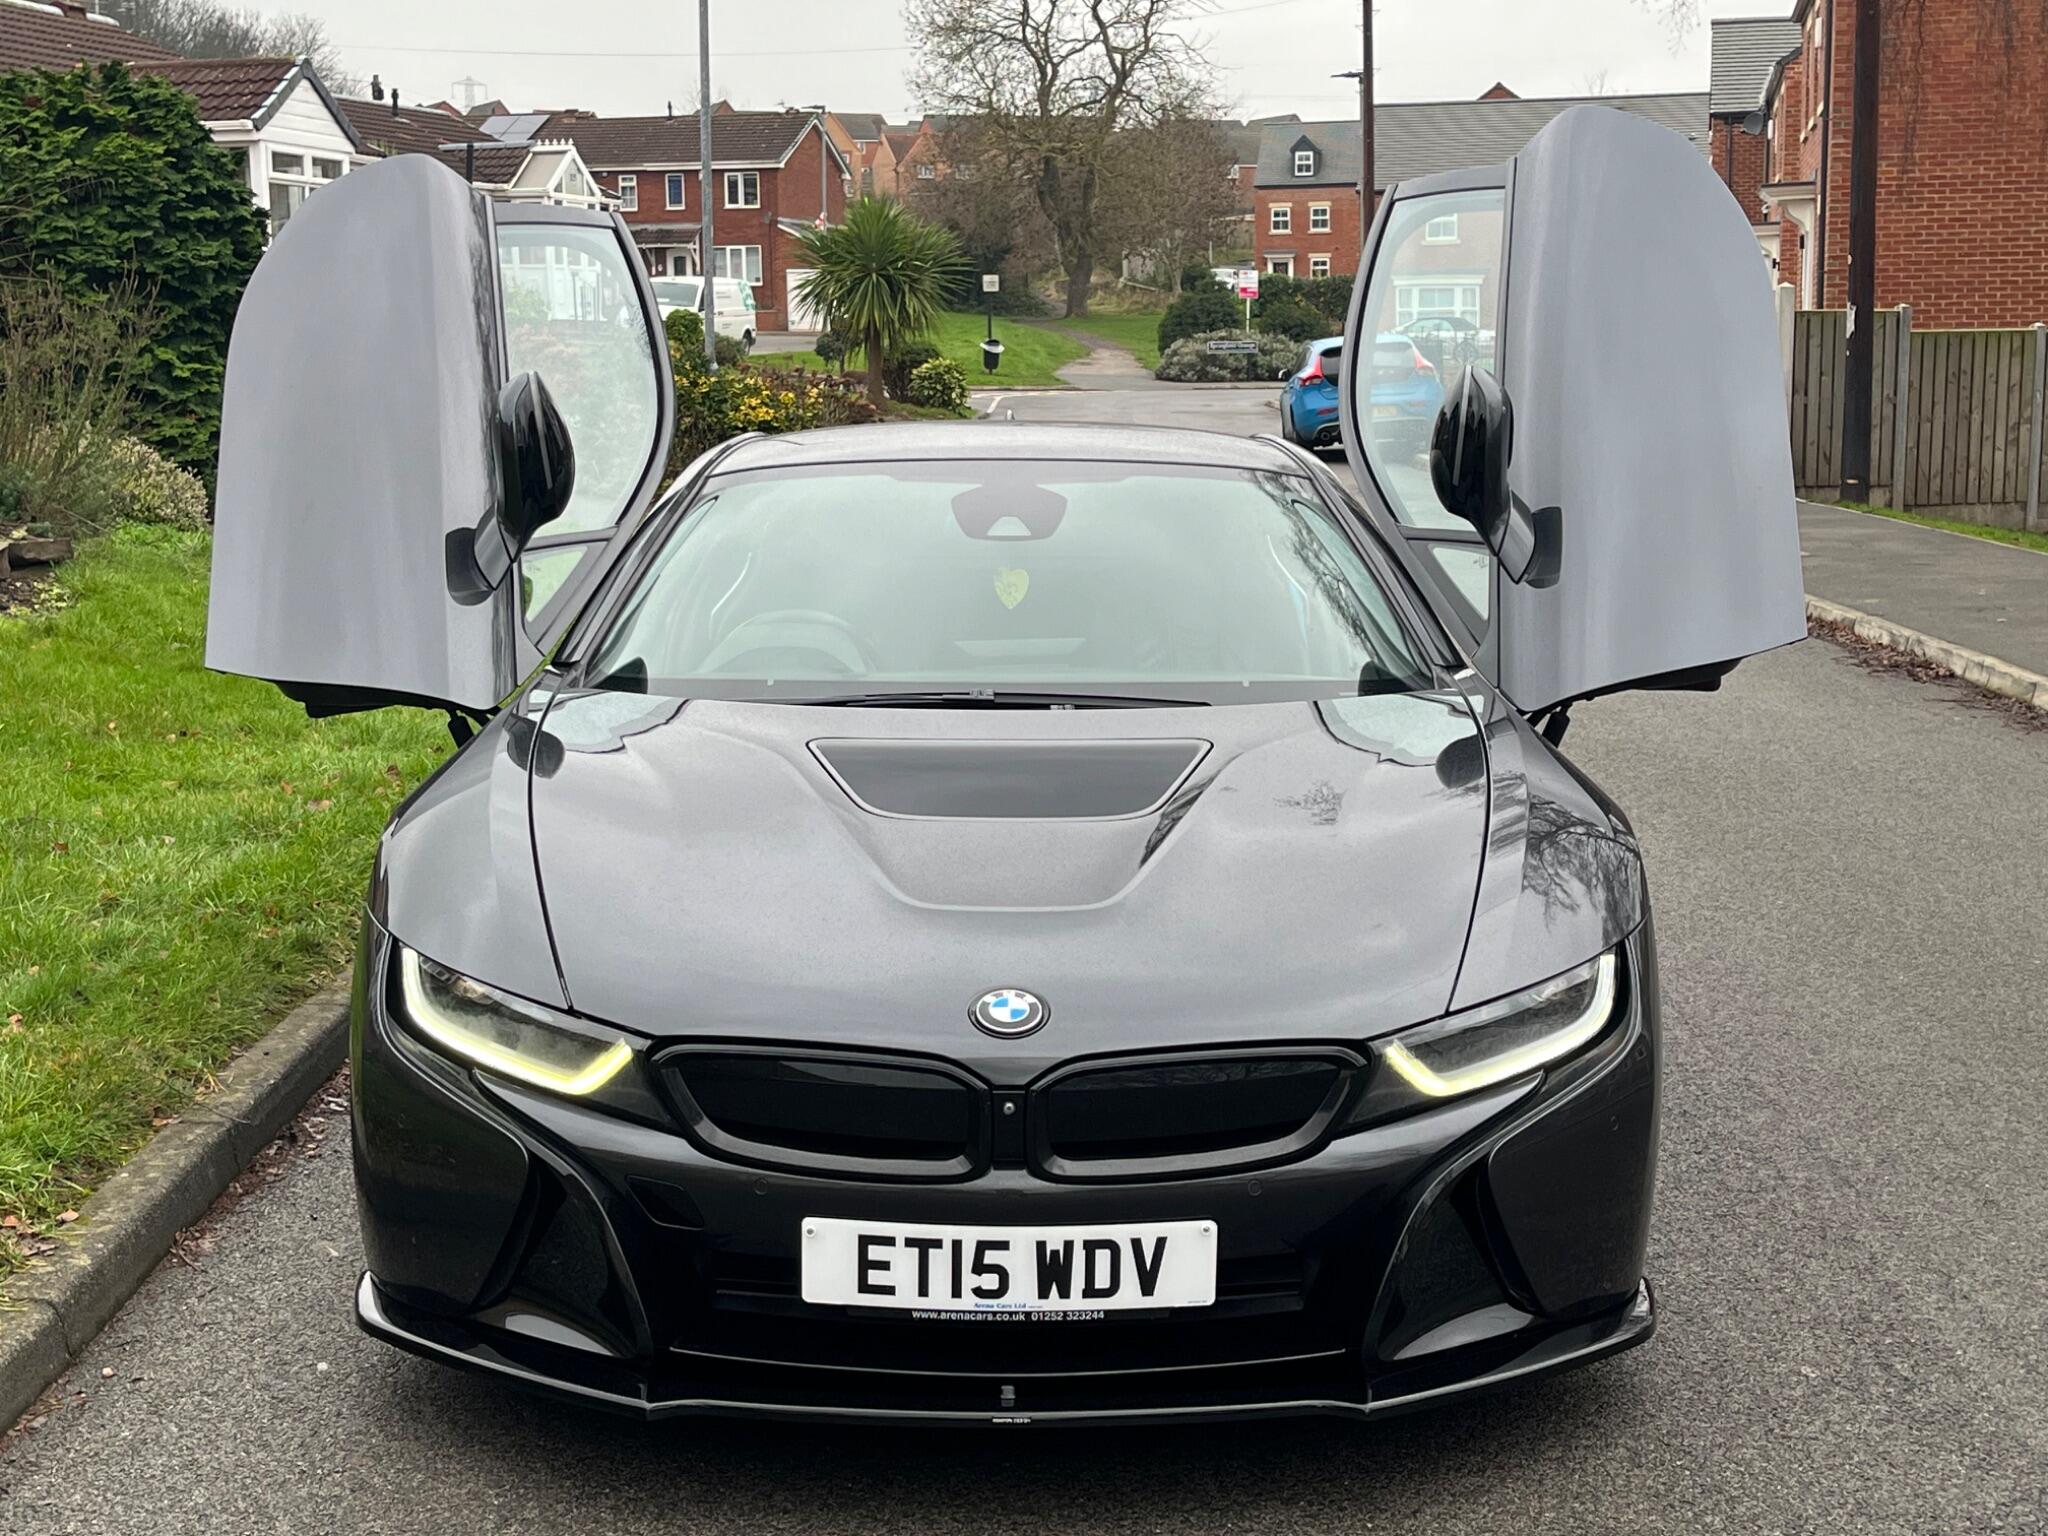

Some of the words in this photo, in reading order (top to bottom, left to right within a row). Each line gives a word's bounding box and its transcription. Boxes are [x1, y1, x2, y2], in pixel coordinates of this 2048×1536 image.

[857, 1234, 1010, 1300] ET15
[1035, 1236, 1169, 1299] WDV
[911, 1310, 1026, 1321] www.arenacars.co.uk
[1031, 1311, 1063, 1321] 01252
[1066, 1310, 1105, 1320] 323244
